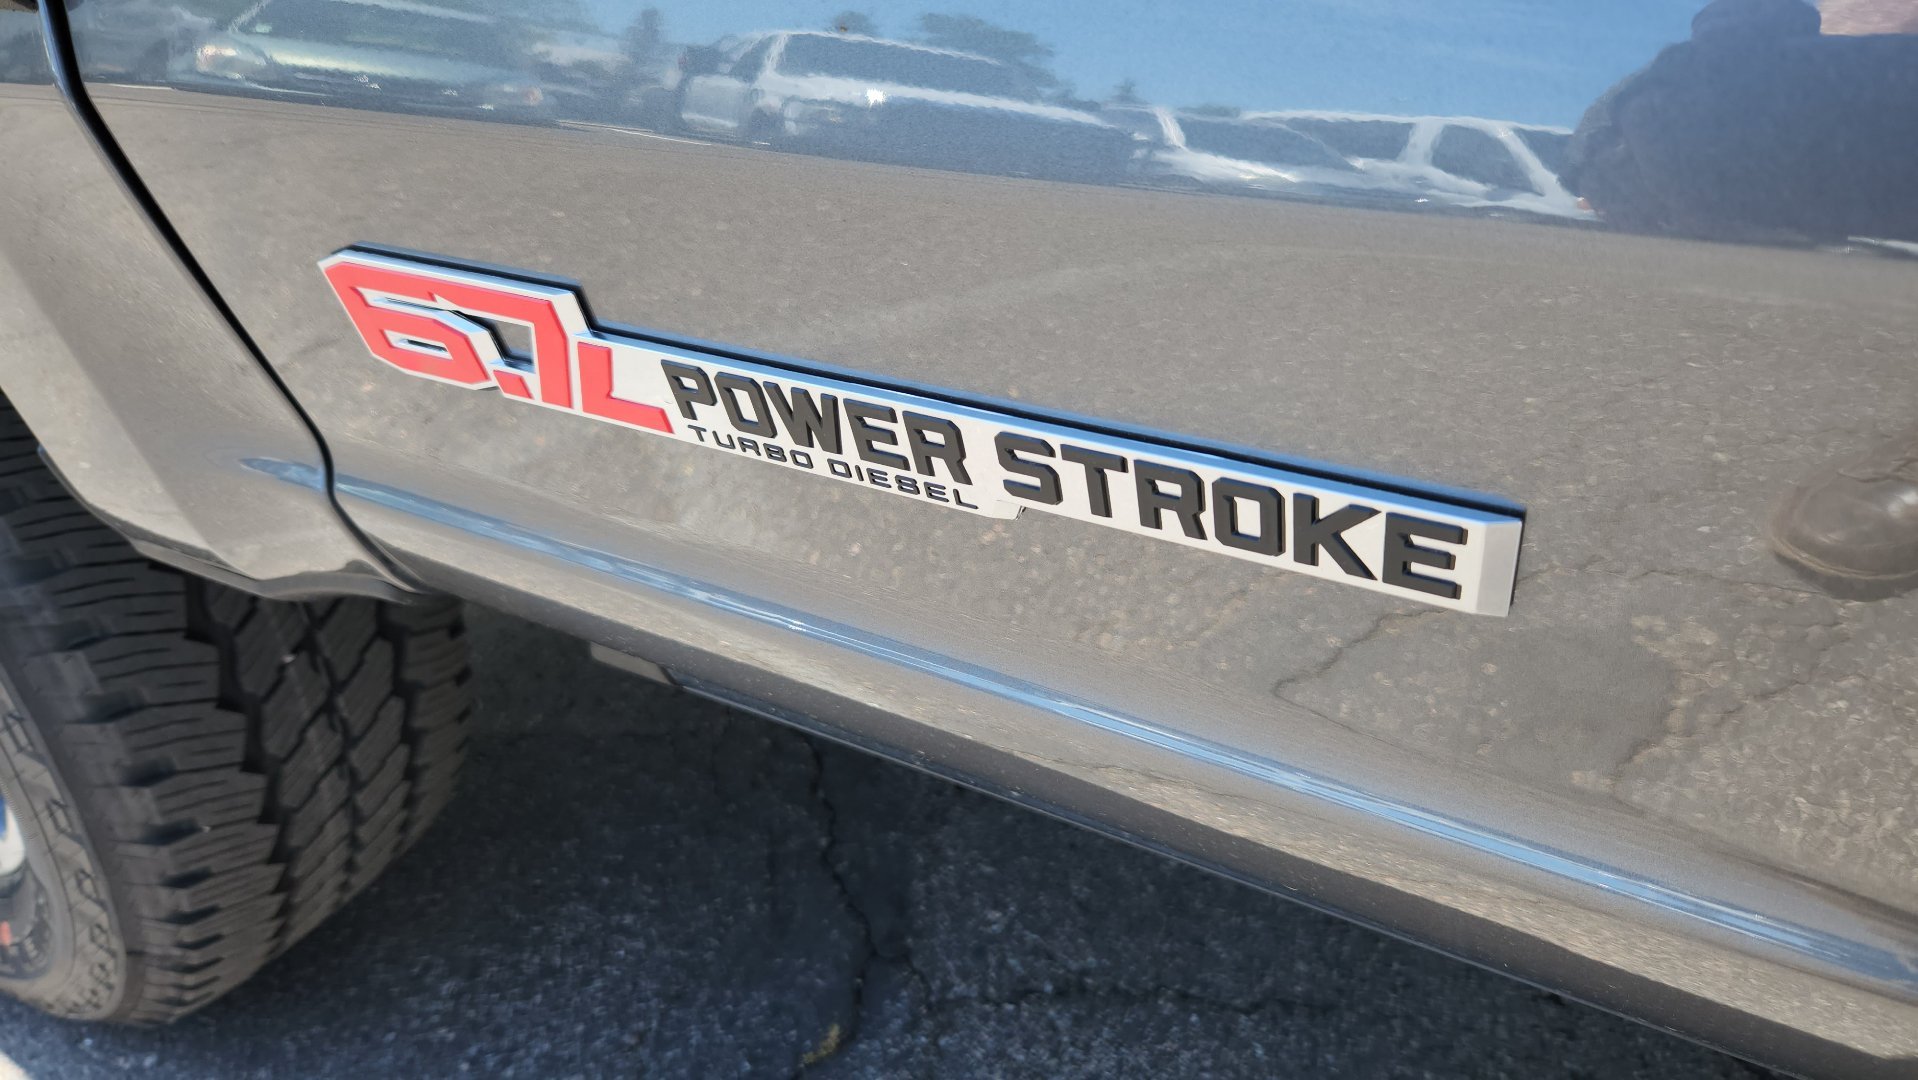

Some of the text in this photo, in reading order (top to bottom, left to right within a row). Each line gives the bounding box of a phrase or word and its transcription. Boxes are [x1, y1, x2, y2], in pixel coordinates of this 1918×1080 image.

[324, 261, 1468, 600] 6.7L POWER STROKE
[687, 424, 979, 510] TURBO DIESEL
